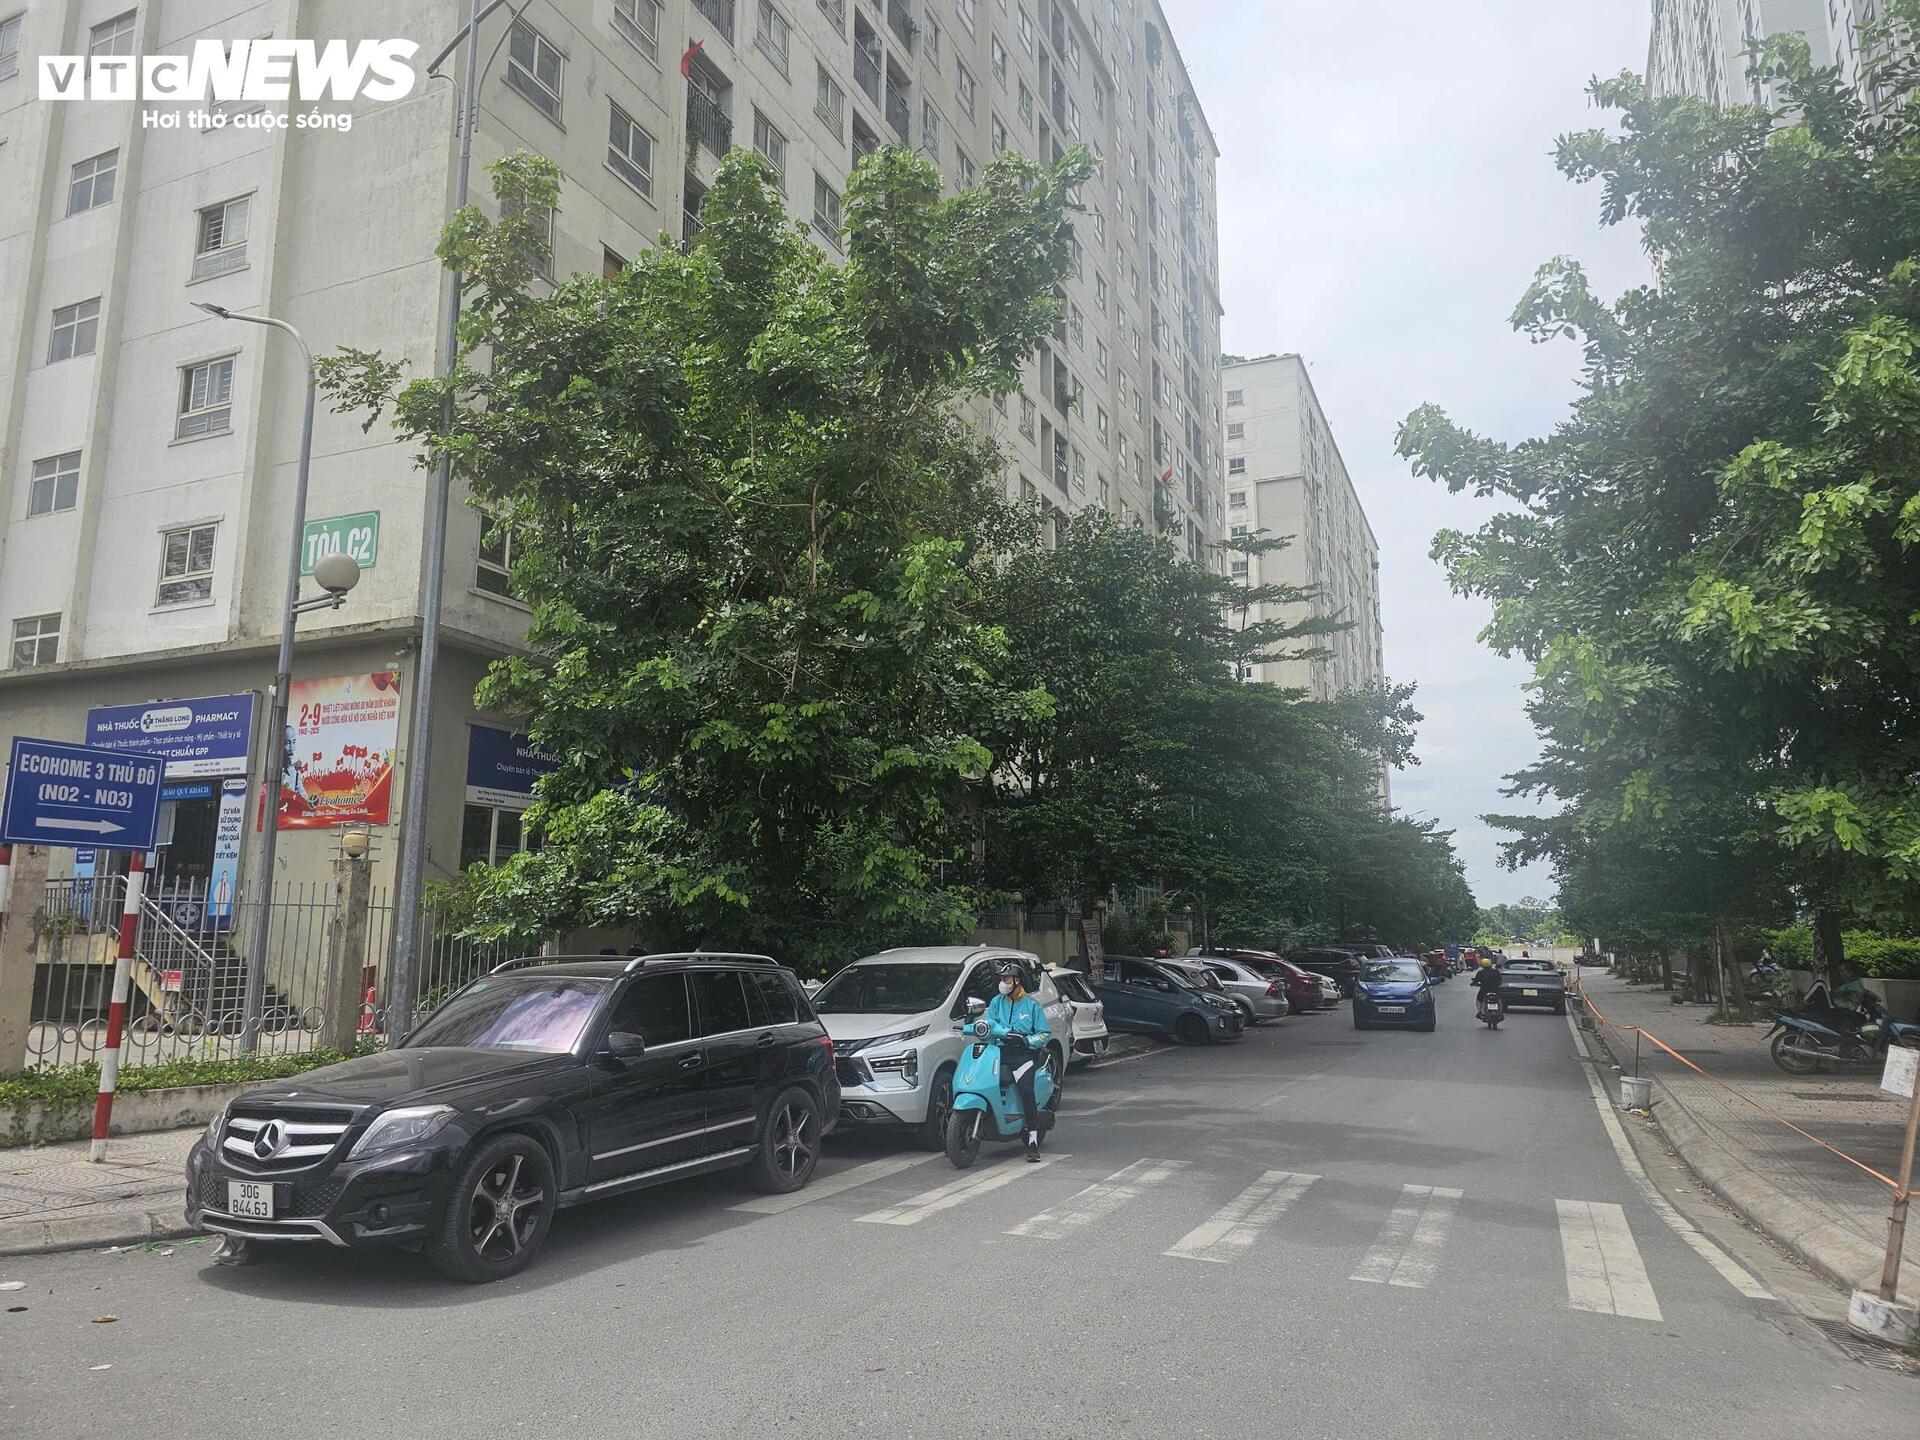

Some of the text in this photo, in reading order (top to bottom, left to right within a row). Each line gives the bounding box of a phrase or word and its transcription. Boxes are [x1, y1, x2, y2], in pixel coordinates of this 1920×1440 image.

[308, 525, 372, 567] TÒA C2
[97, 720, 113, 732] NHÀ
[115, 717, 140, 731] THUỐC
[174, 714, 190, 722] LONG
[195, 711, 239, 724] PHARMACY
[300, 702, 321, 727] 2-9
[195, 747, 208, 756] GPP
[20, 754, 156, 785] ECOHOME 3 THỦ ĐÔ
[240, 1184, 259, 1199] 30G
[233, 1199, 268, 1216] 844.63
